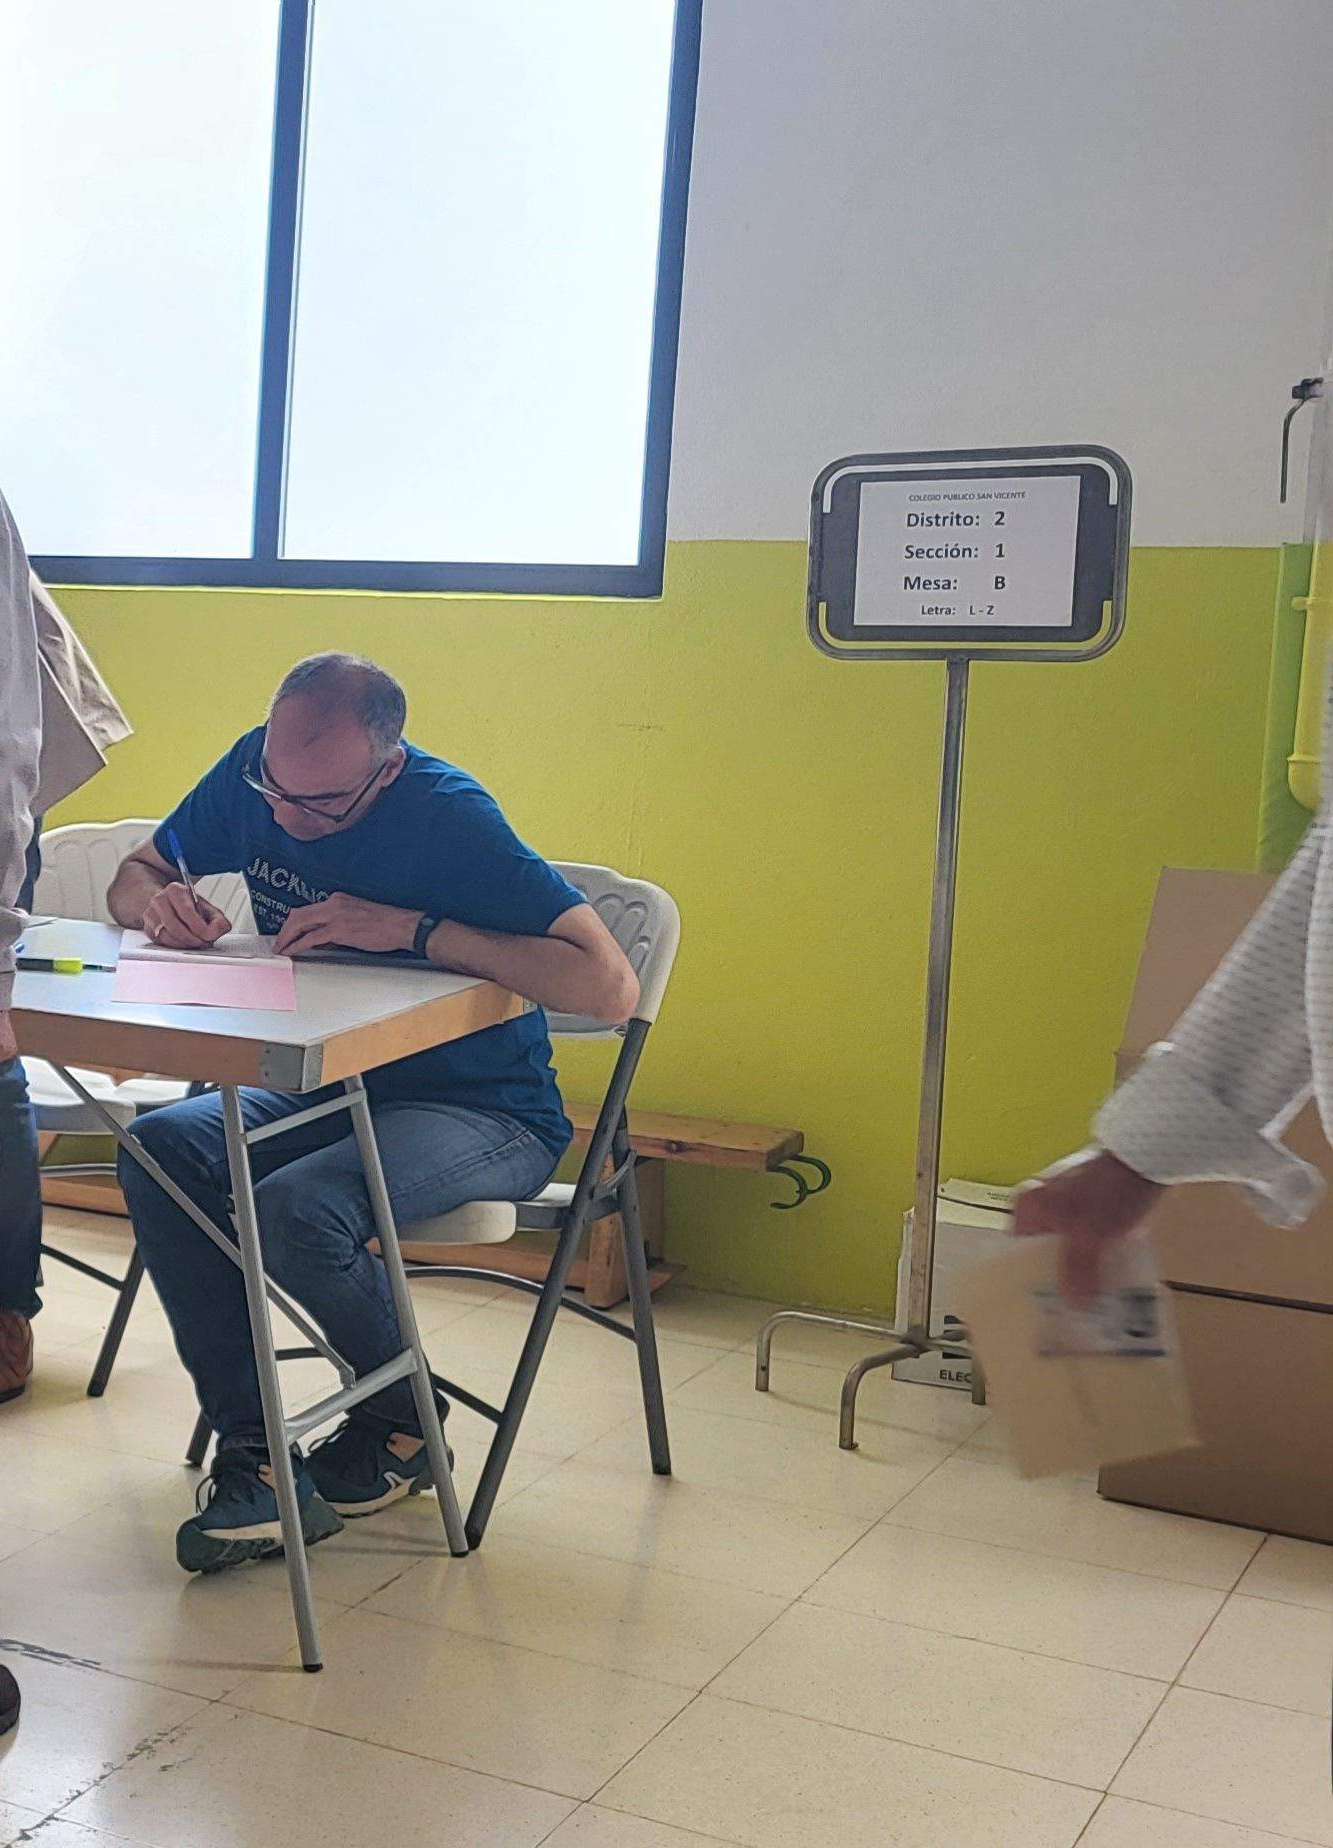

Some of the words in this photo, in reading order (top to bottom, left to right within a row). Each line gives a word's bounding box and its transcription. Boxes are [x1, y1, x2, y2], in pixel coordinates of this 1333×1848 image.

[908, 494, 941, 502] COLEGIO
[977, 492, 993, 500] SAN
[994, 491, 1026, 499] VICENTE
[906, 511, 980, 528] Distrito:
[994, 511, 1006, 526] 2
[904, 543, 979, 559] Sección:
[995, 543, 1005, 558] 1
[903, 576, 958, 590] Mesa:
[994, 575, 1006, 590] B
[921, 605, 956, 615] Letra:
[969, 605, 976, 615] L
[986, 605, 995, 615] Z
